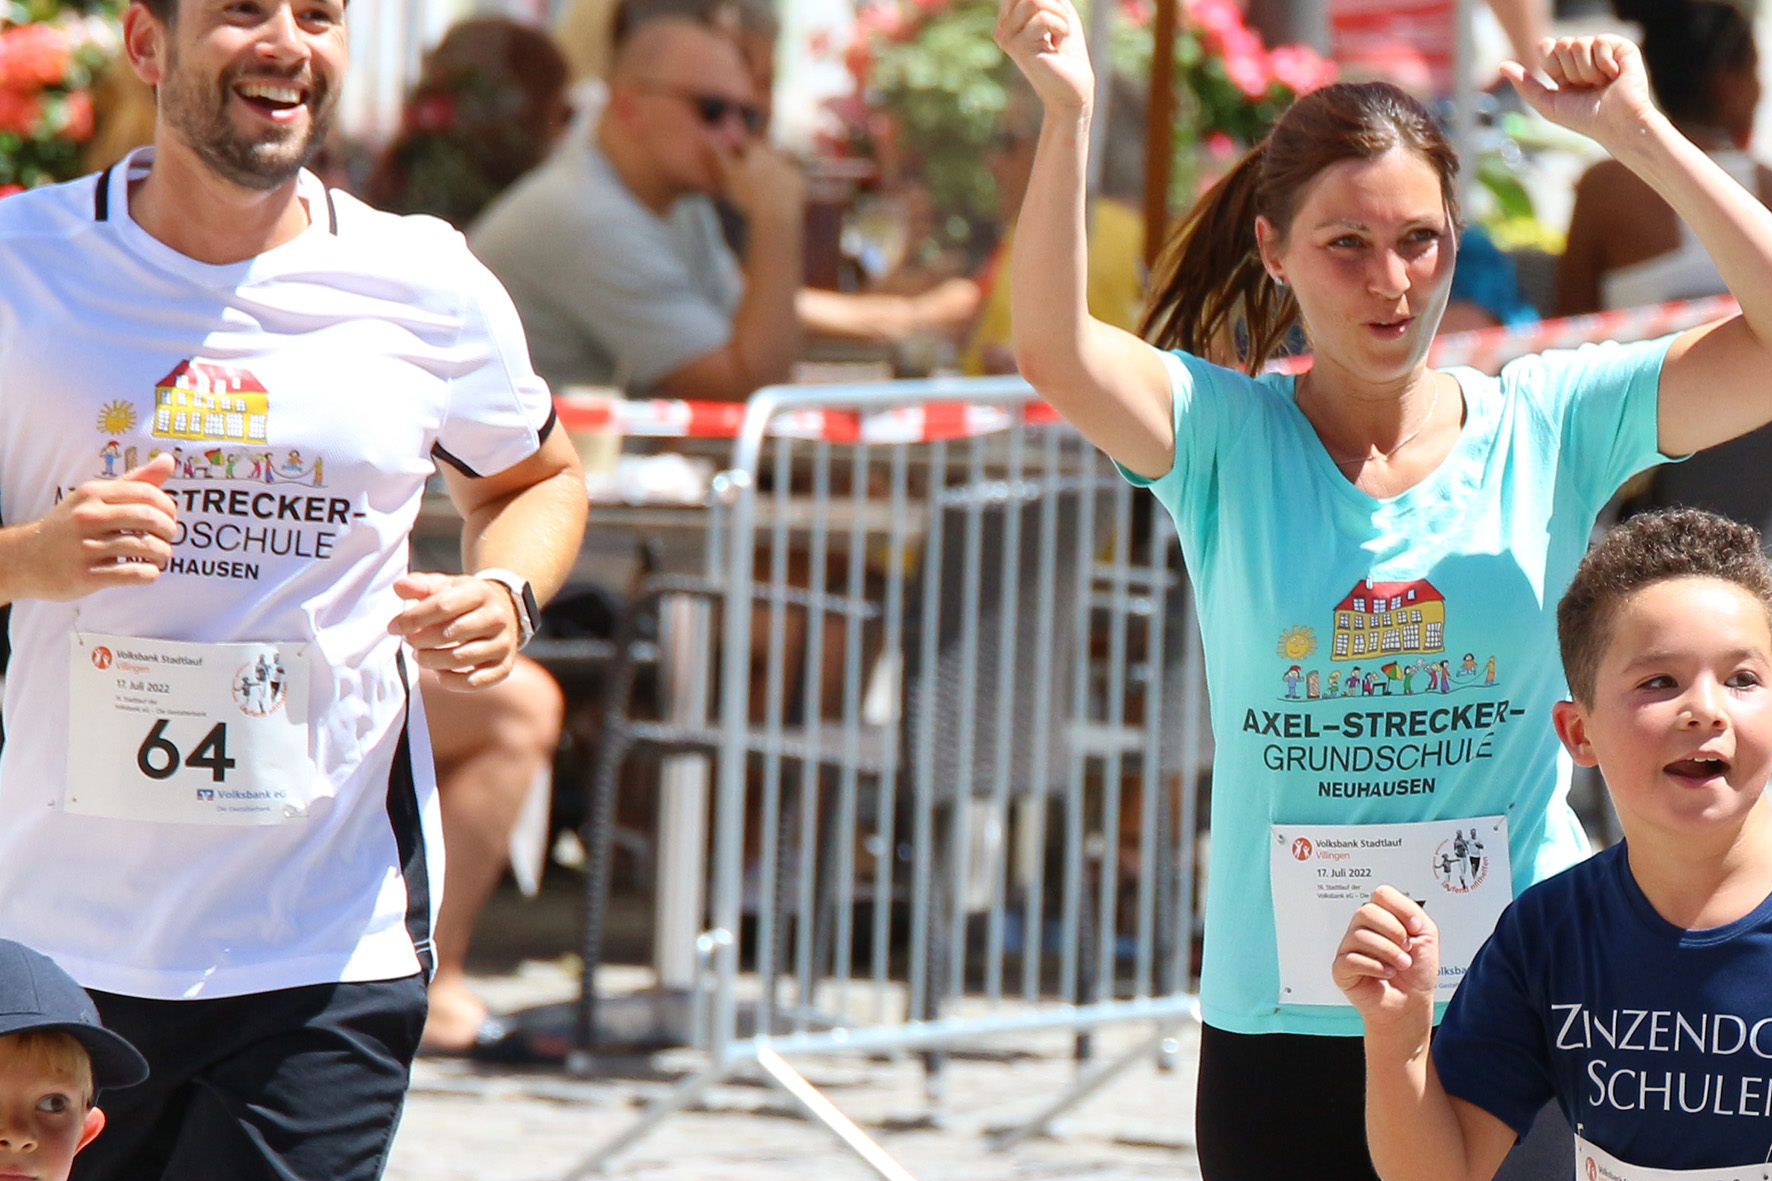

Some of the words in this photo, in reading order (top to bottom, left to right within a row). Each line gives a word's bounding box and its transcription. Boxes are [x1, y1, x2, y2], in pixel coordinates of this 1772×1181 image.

[116, 650, 159, 663] Volksbank
[161, 656, 203, 666] Stadtlauf
[130, 680, 144, 690] Juli
[147, 683, 170, 693] 2022
[1242, 700, 1525, 738] AXEL-STRECKER-
[137, 719, 235, 782] 64
[1263, 732, 1494, 772] GRUNDSCHULE
[218, 790, 271, 799] Volksbank
[1318, 777, 1436, 798] NEUHAUSEN
[1315, 838, 1358, 849] Volksbank
[1360, 837, 1402, 848] Stadtlauf
[1316, 851, 1350, 862] Villingen
[1317, 868, 1329, 878] 17.
[1331, 868, 1346, 878] Juli
[1349, 868, 1371, 878] 2022
